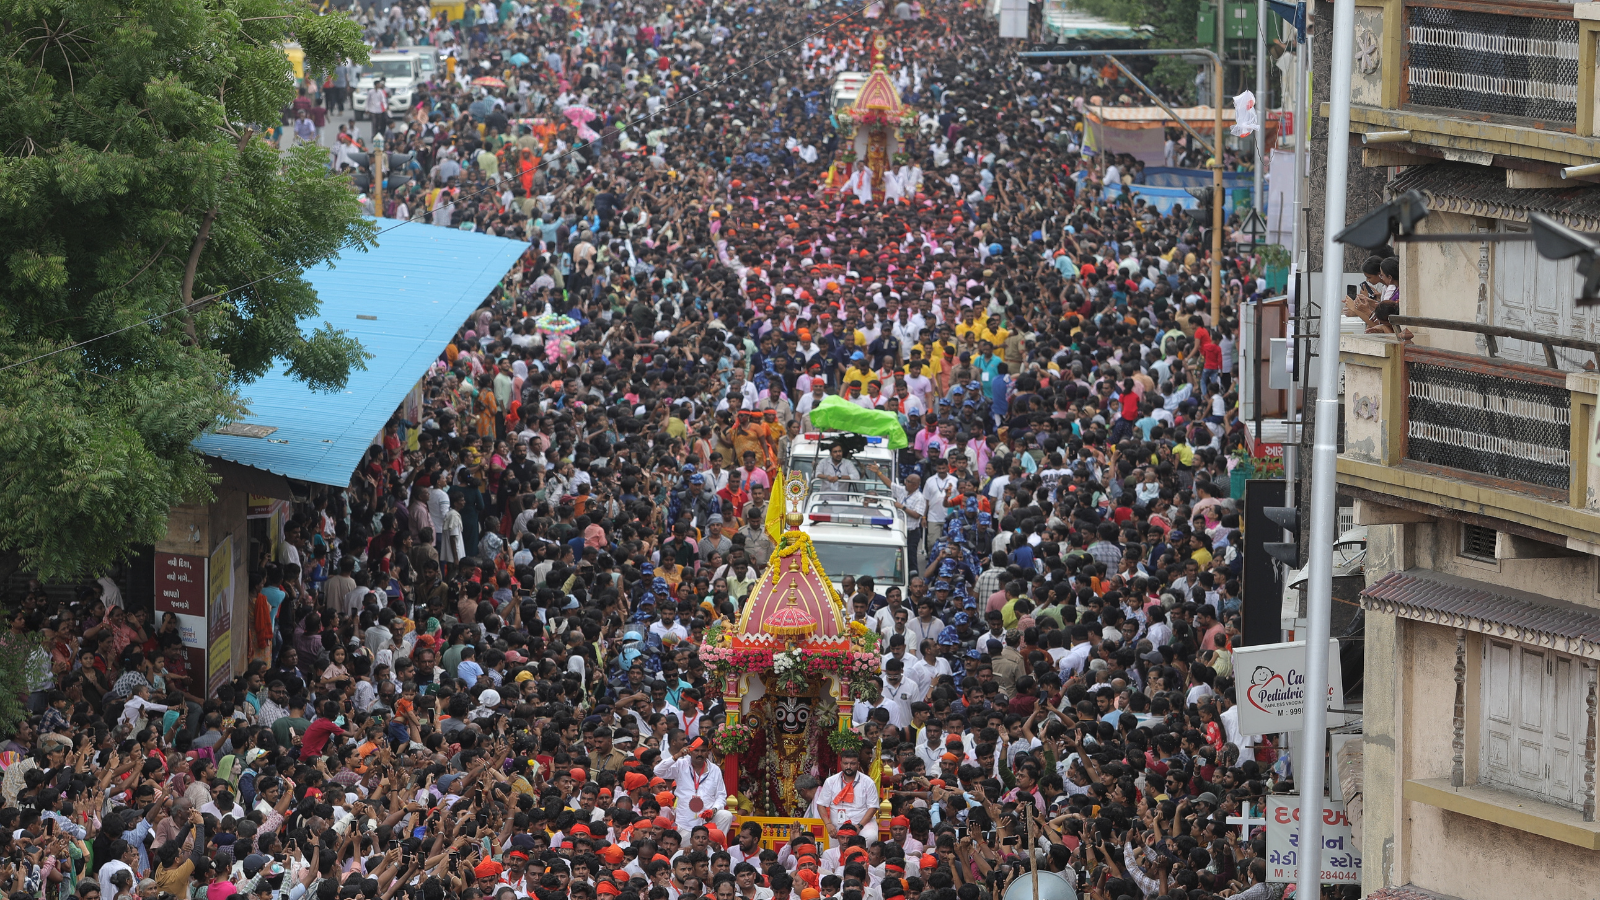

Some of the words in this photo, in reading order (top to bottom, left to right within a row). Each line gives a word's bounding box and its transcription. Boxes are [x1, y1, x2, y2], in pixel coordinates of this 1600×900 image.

[1259, 688, 1304, 703] Pediatric
[1278, 709, 1283, 717] M
[1275, 869, 1283, 877] M
